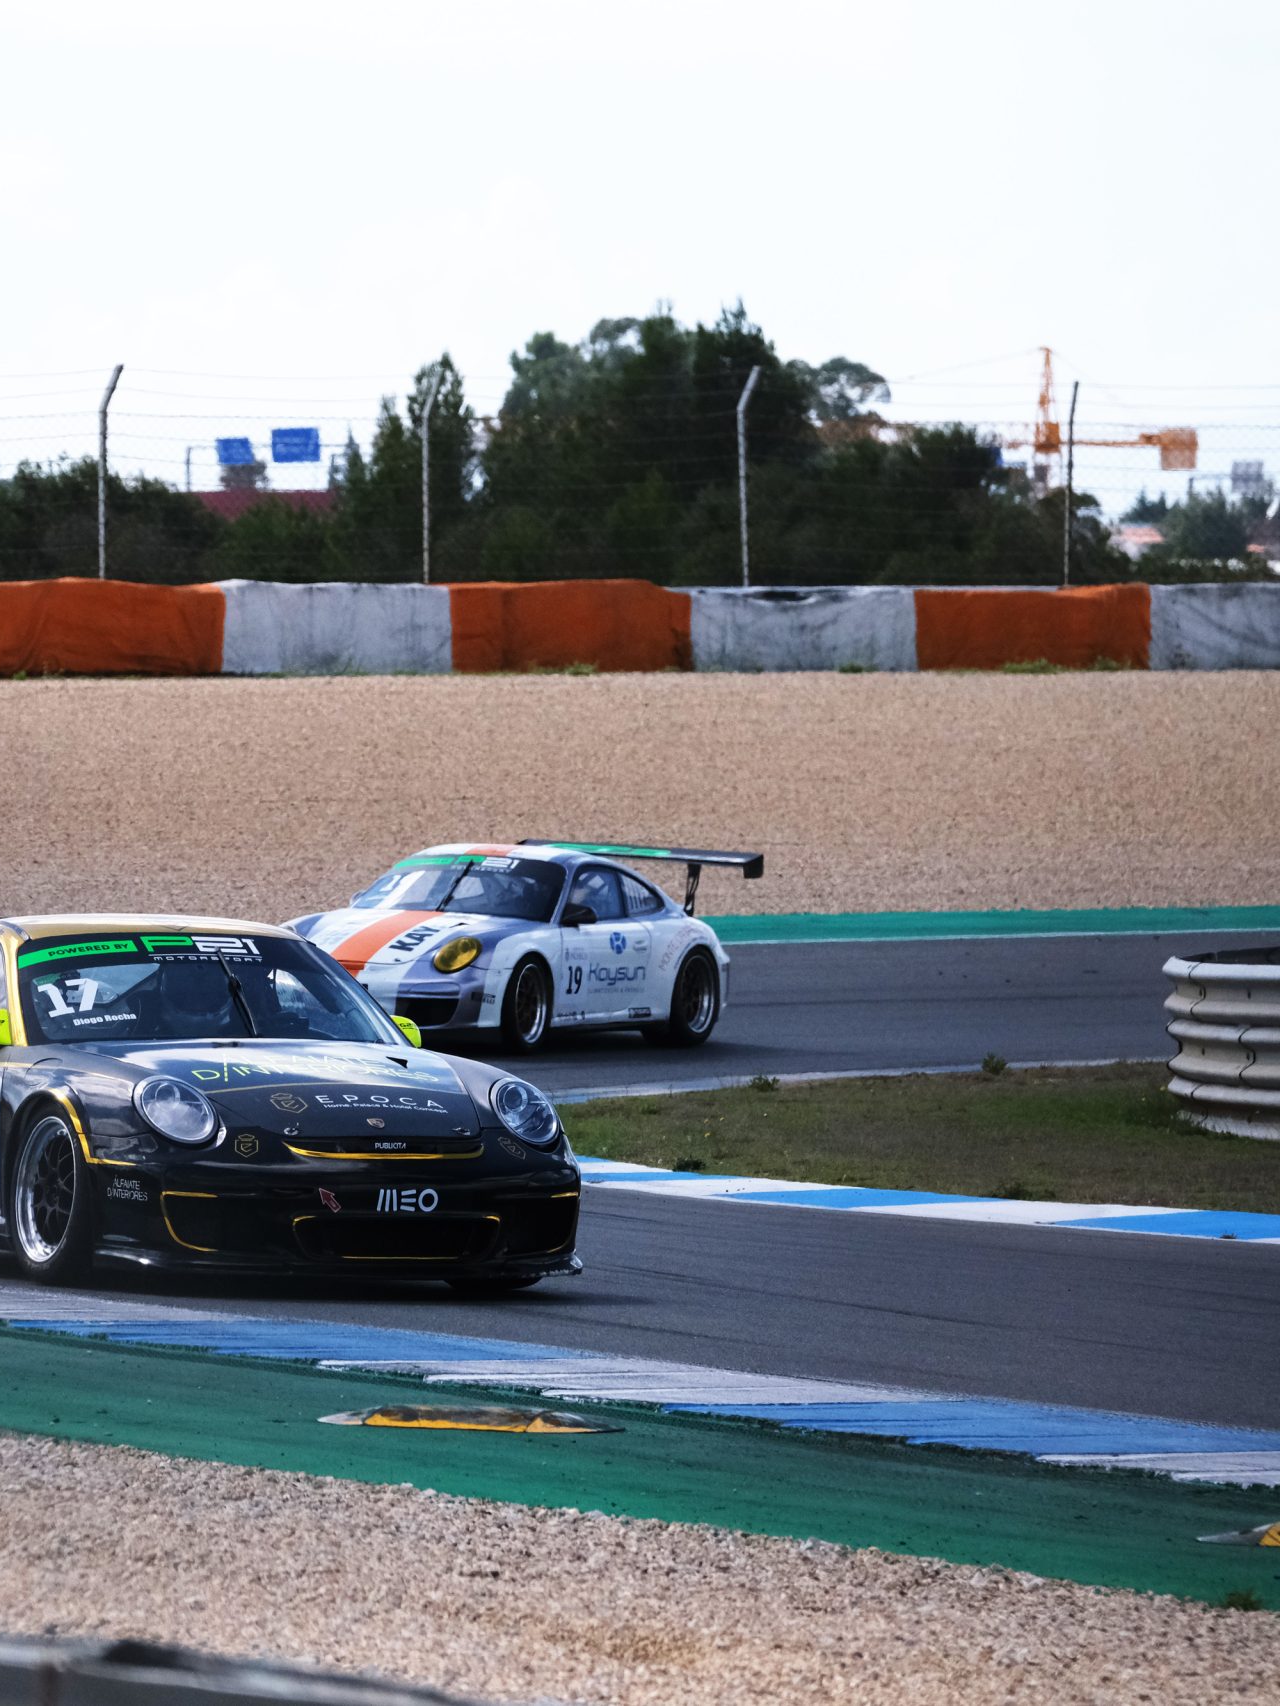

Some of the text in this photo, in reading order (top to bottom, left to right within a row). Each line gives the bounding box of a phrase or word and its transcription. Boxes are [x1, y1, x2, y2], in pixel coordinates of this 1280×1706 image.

[139, 935, 262, 955] P21
[388, 925, 441, 952] KAY
[48, 942, 129, 957] POWERED BY
[153, 955, 263, 963] MOTORSPORT
[565, 965, 583, 995] 19
[588, 962, 646, 986] Kaysun
[37, 977, 99, 1018] 17
[73, 1013, 137, 1027] Diogo Rocha
[315, 1094, 444, 1109] EPOCA
